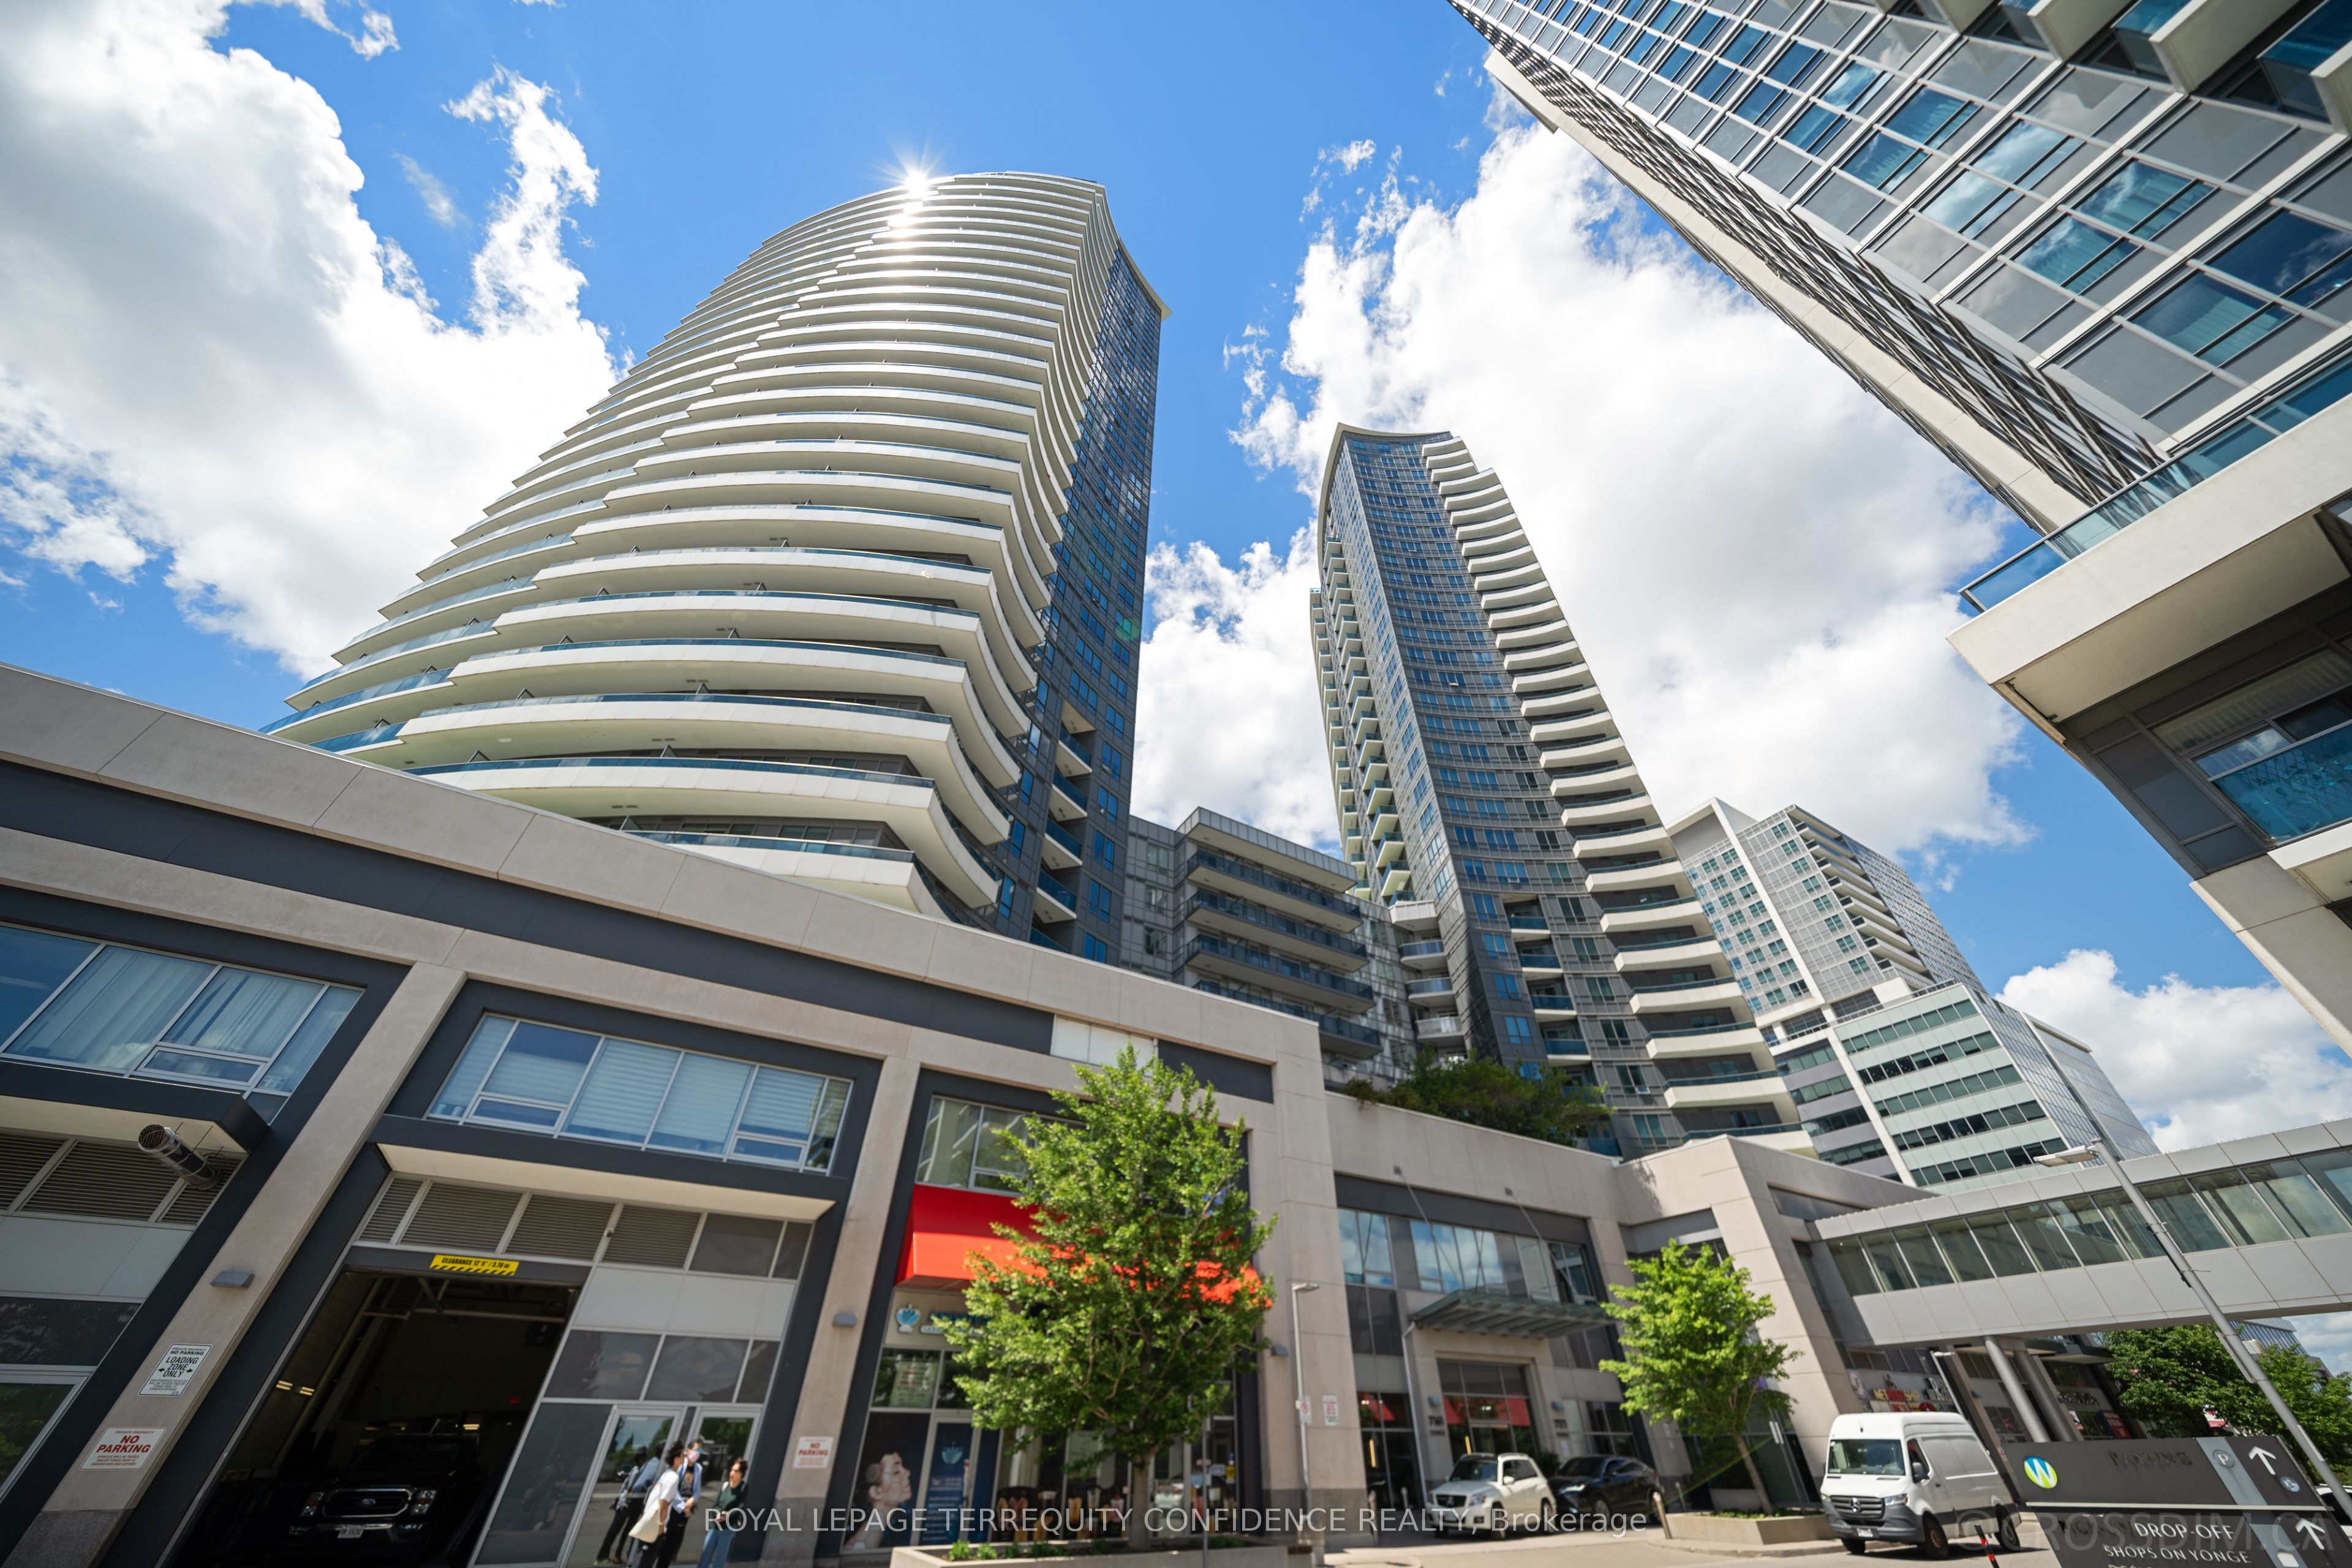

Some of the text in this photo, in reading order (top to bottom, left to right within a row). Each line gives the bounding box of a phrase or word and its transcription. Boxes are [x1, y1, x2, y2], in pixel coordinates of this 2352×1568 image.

[442, 1257, 472, 1265] CLEARANCE
[120, 1435, 140, 1444] NO
[96, 1444, 151, 1453] PARKING
[2217, 1453, 2228, 1465] P
[2134, 1522, 2235, 1542] DROP-OFF
[2103, 1544, 2252, 1564] SHOPS ON YONGE
